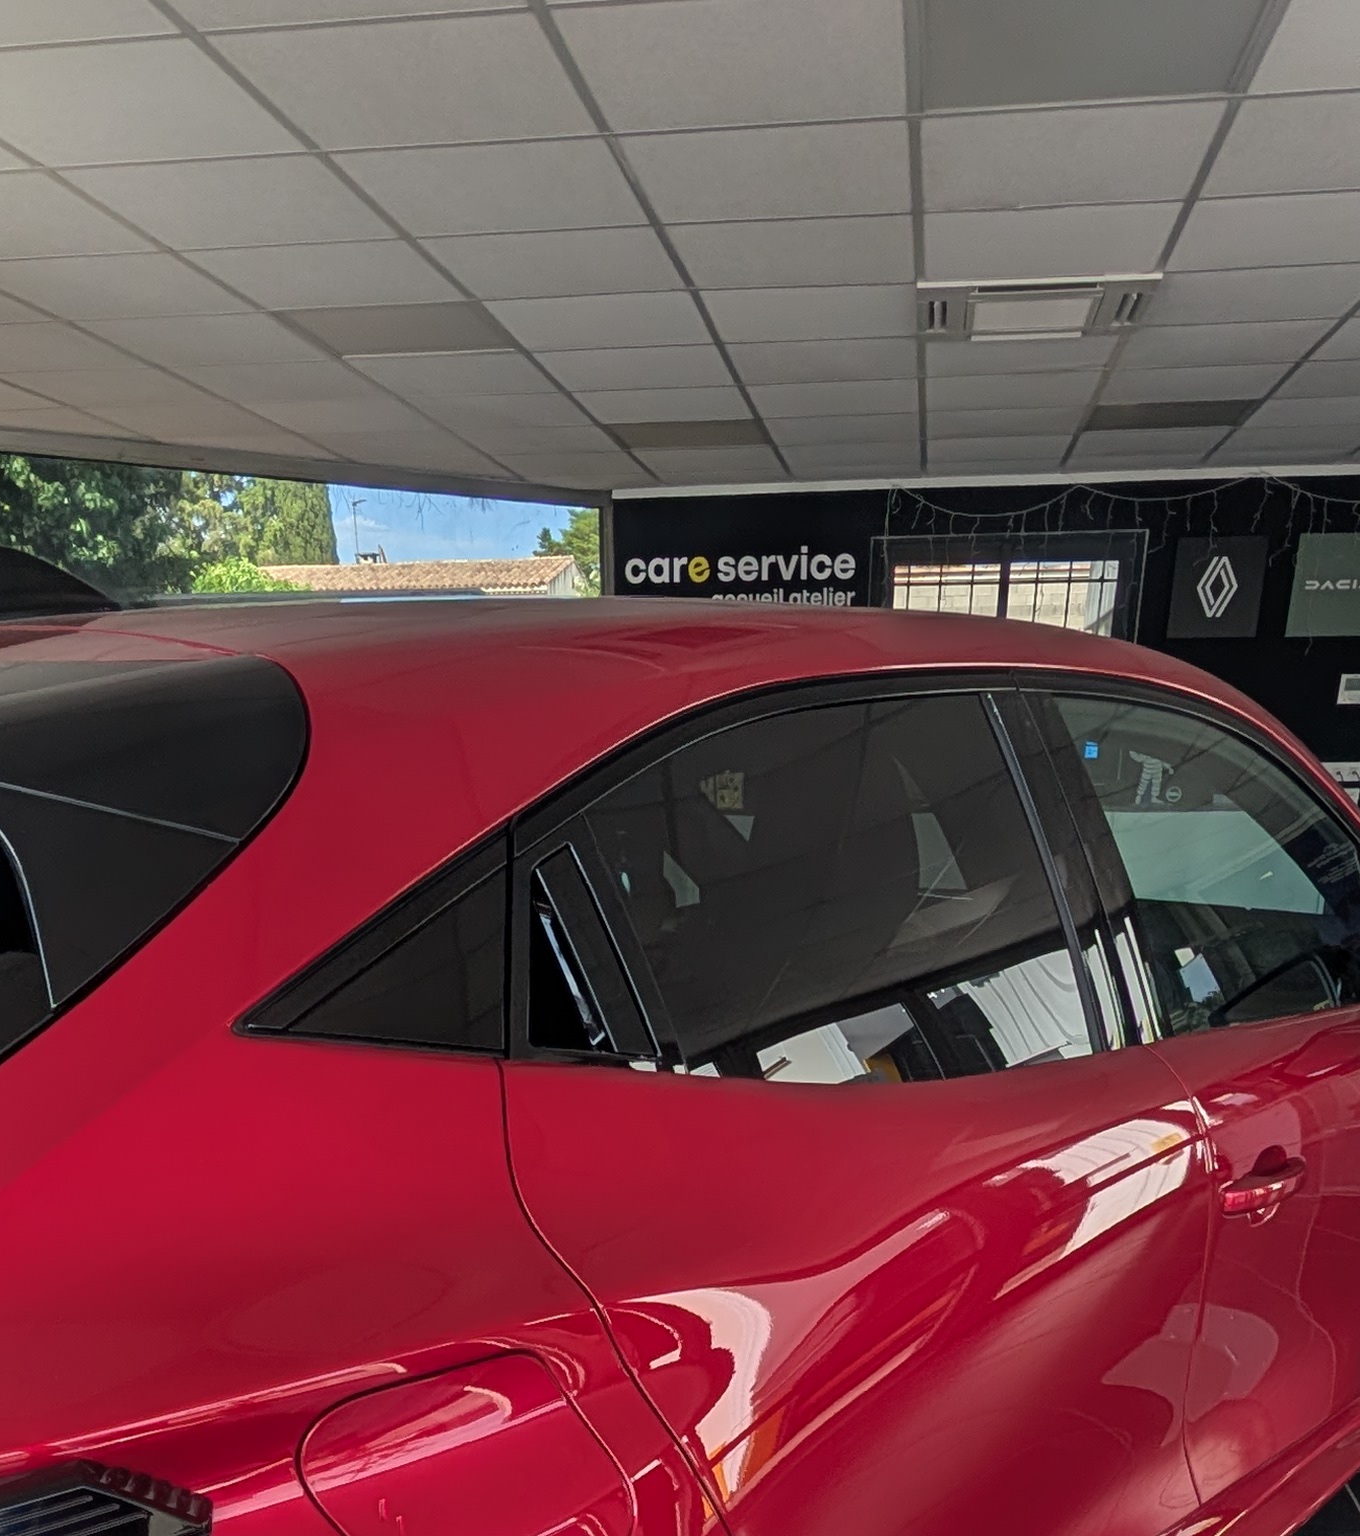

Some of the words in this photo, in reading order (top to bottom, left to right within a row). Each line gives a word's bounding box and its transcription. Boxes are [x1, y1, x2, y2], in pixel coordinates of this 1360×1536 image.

[624, 555, 711, 585] care
[717, 545, 857, 583] service
[789, 587, 856, 607] atelier
